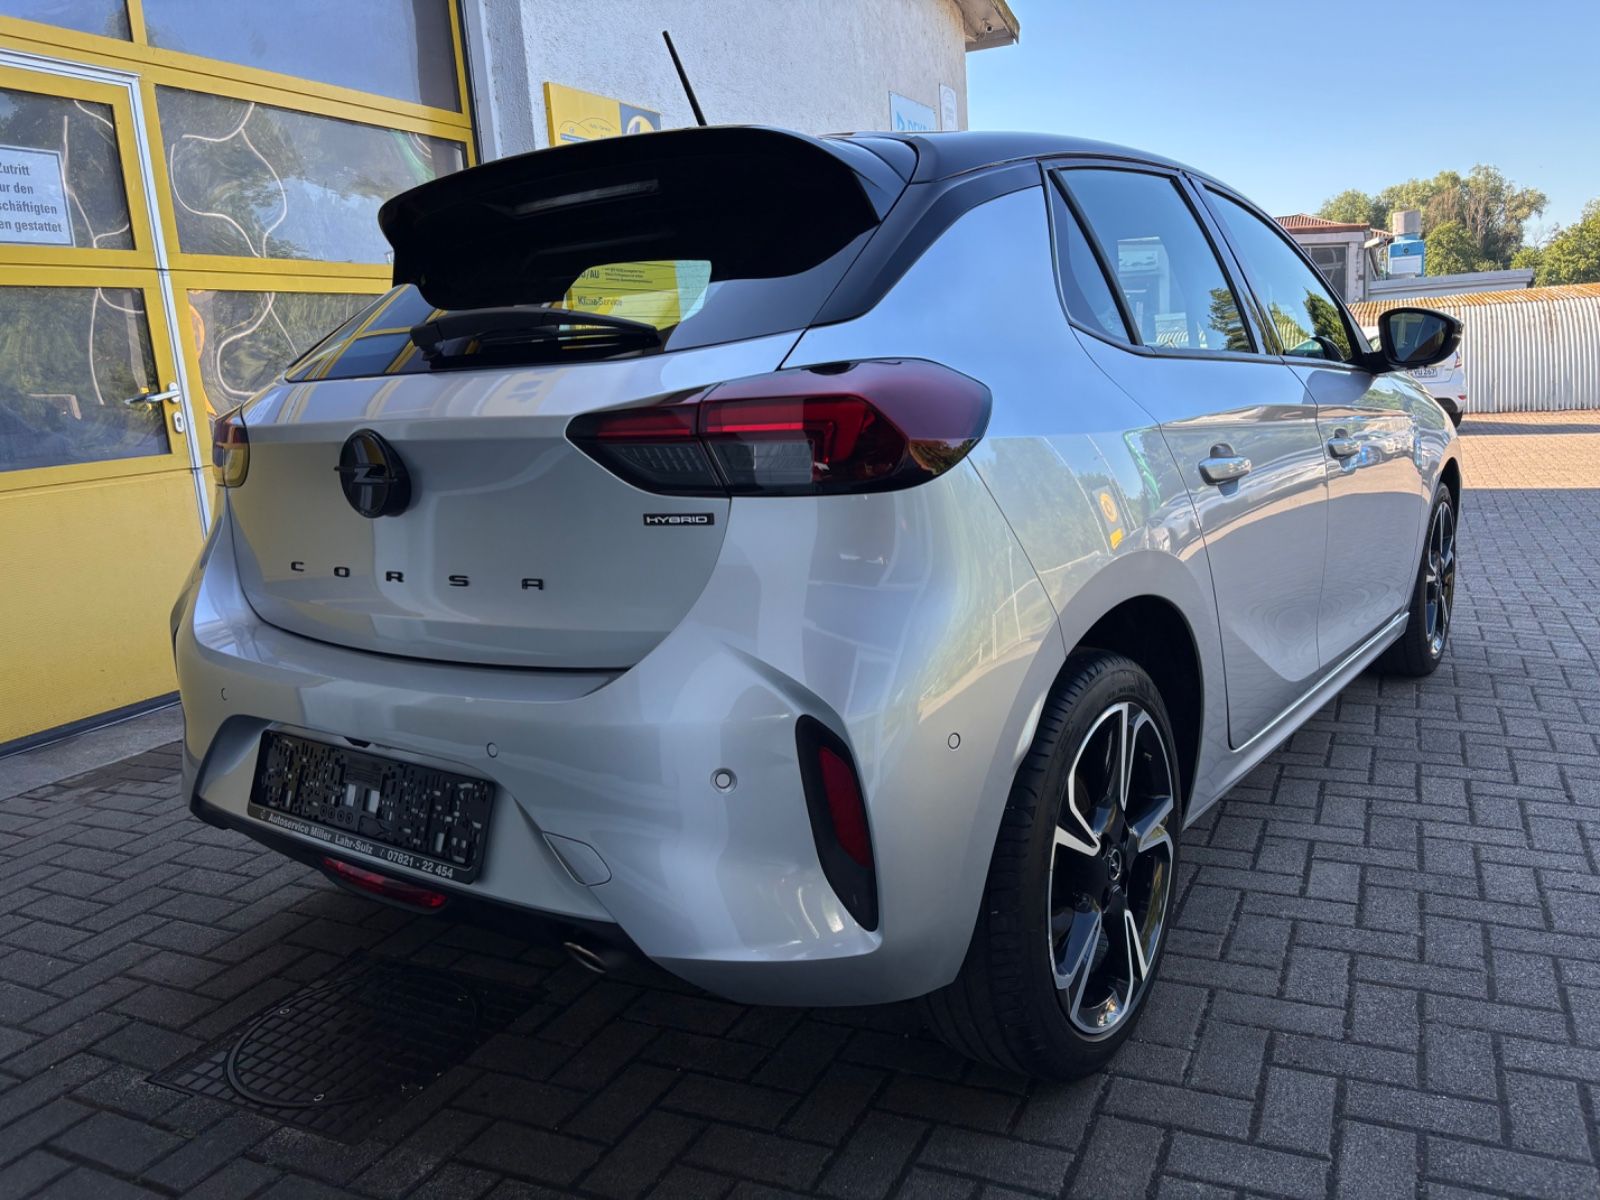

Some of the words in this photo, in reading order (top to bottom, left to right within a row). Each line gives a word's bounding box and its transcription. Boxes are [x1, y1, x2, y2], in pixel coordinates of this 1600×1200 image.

[0, 183, 10, 193] ur
[14, 182, 33, 194] den
[0, 200, 57, 215] chäftigten
[0, 220, 12, 230] en
[15, 221, 63, 233] gestattet
[645, 516, 708, 524] HYBRID
[290, 561, 544, 591] CORSA
[268, 813, 309, 835] Autoservice
[310, 825, 332, 841] Miller
[386, 850, 414, 867] 07821
[421, 860, 434, 873] 22
[435, 864, 454, 879] 454
